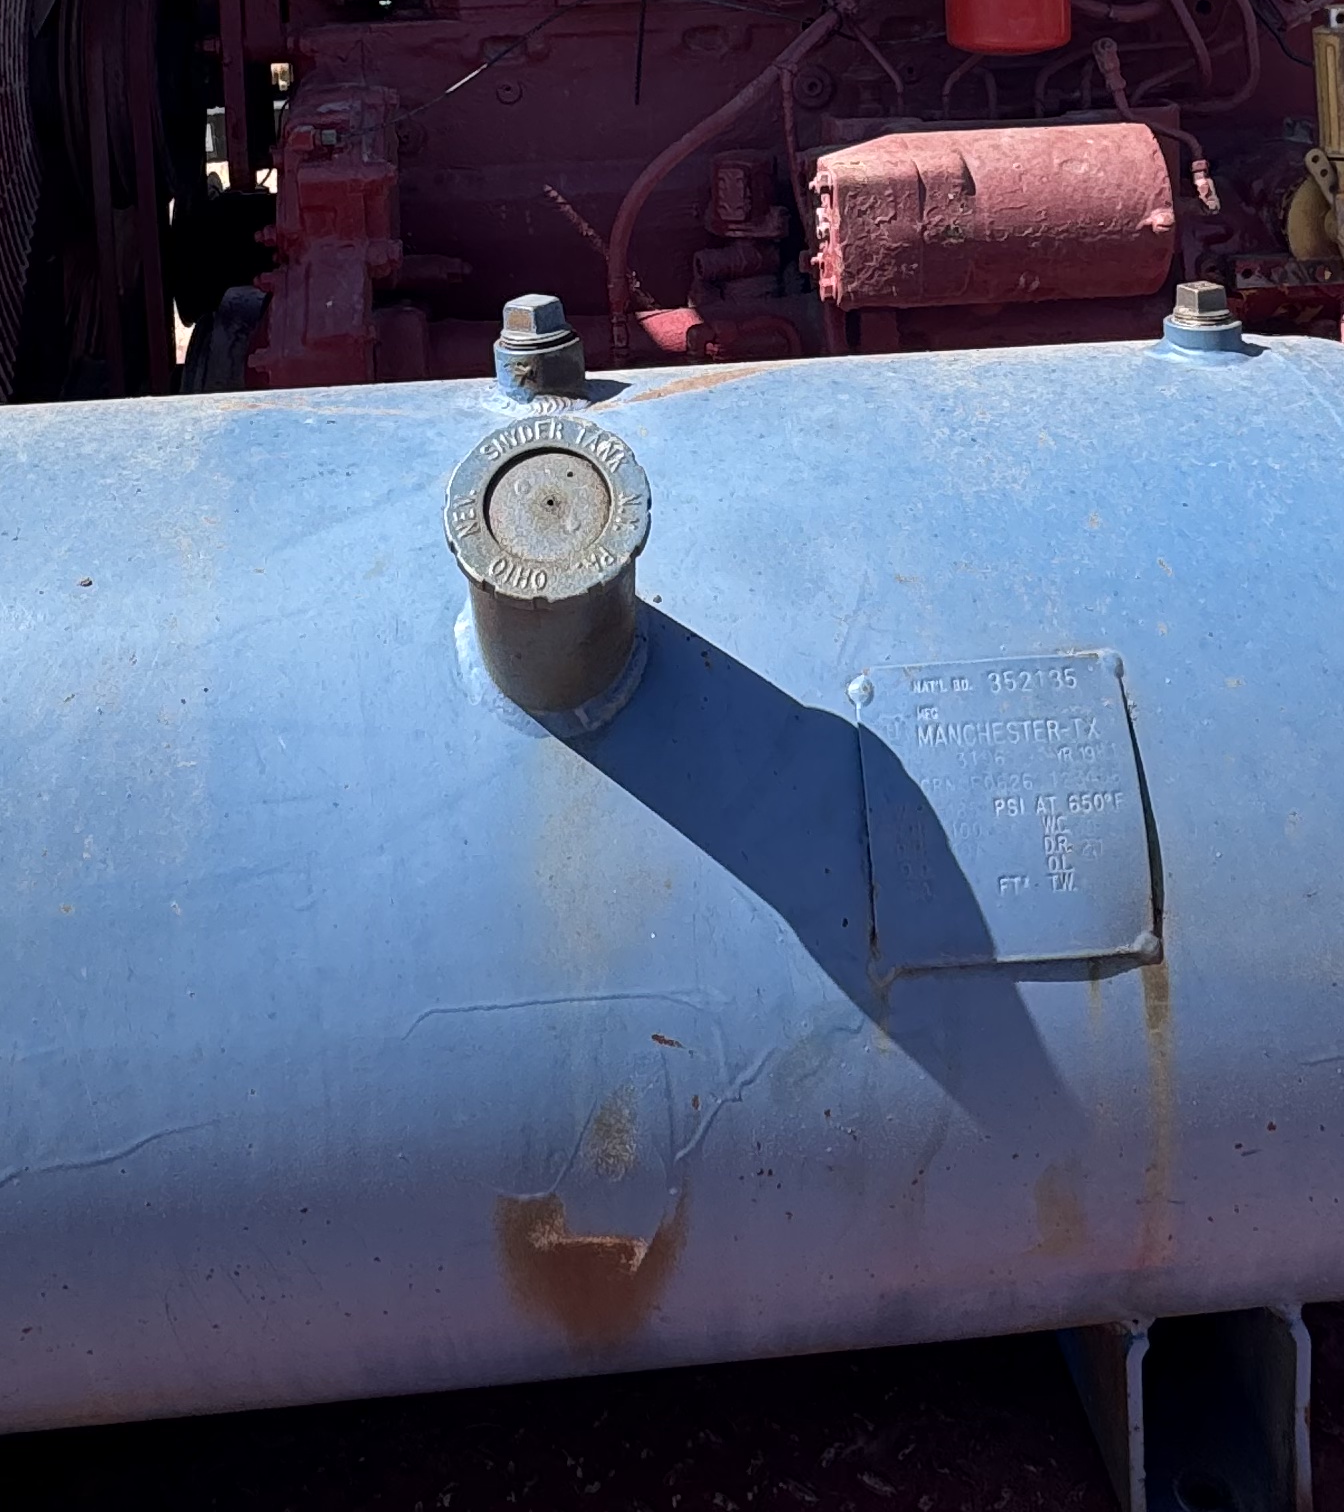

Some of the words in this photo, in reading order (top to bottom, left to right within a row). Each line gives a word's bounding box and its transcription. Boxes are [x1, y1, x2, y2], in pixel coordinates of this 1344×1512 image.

[479, 418, 564, 461] SNYDER
[575, 425, 625, 473] TANK
[488, 557, 548, 589] OHIO
[912, 678, 948, 694] NAT'L
[987, 668, 1077, 693] 352135
[917, 717, 1100, 747] MANCHESTER-TX
[994, 797, 1025, 817] PSI
[1036, 795, 1057, 816] AT
